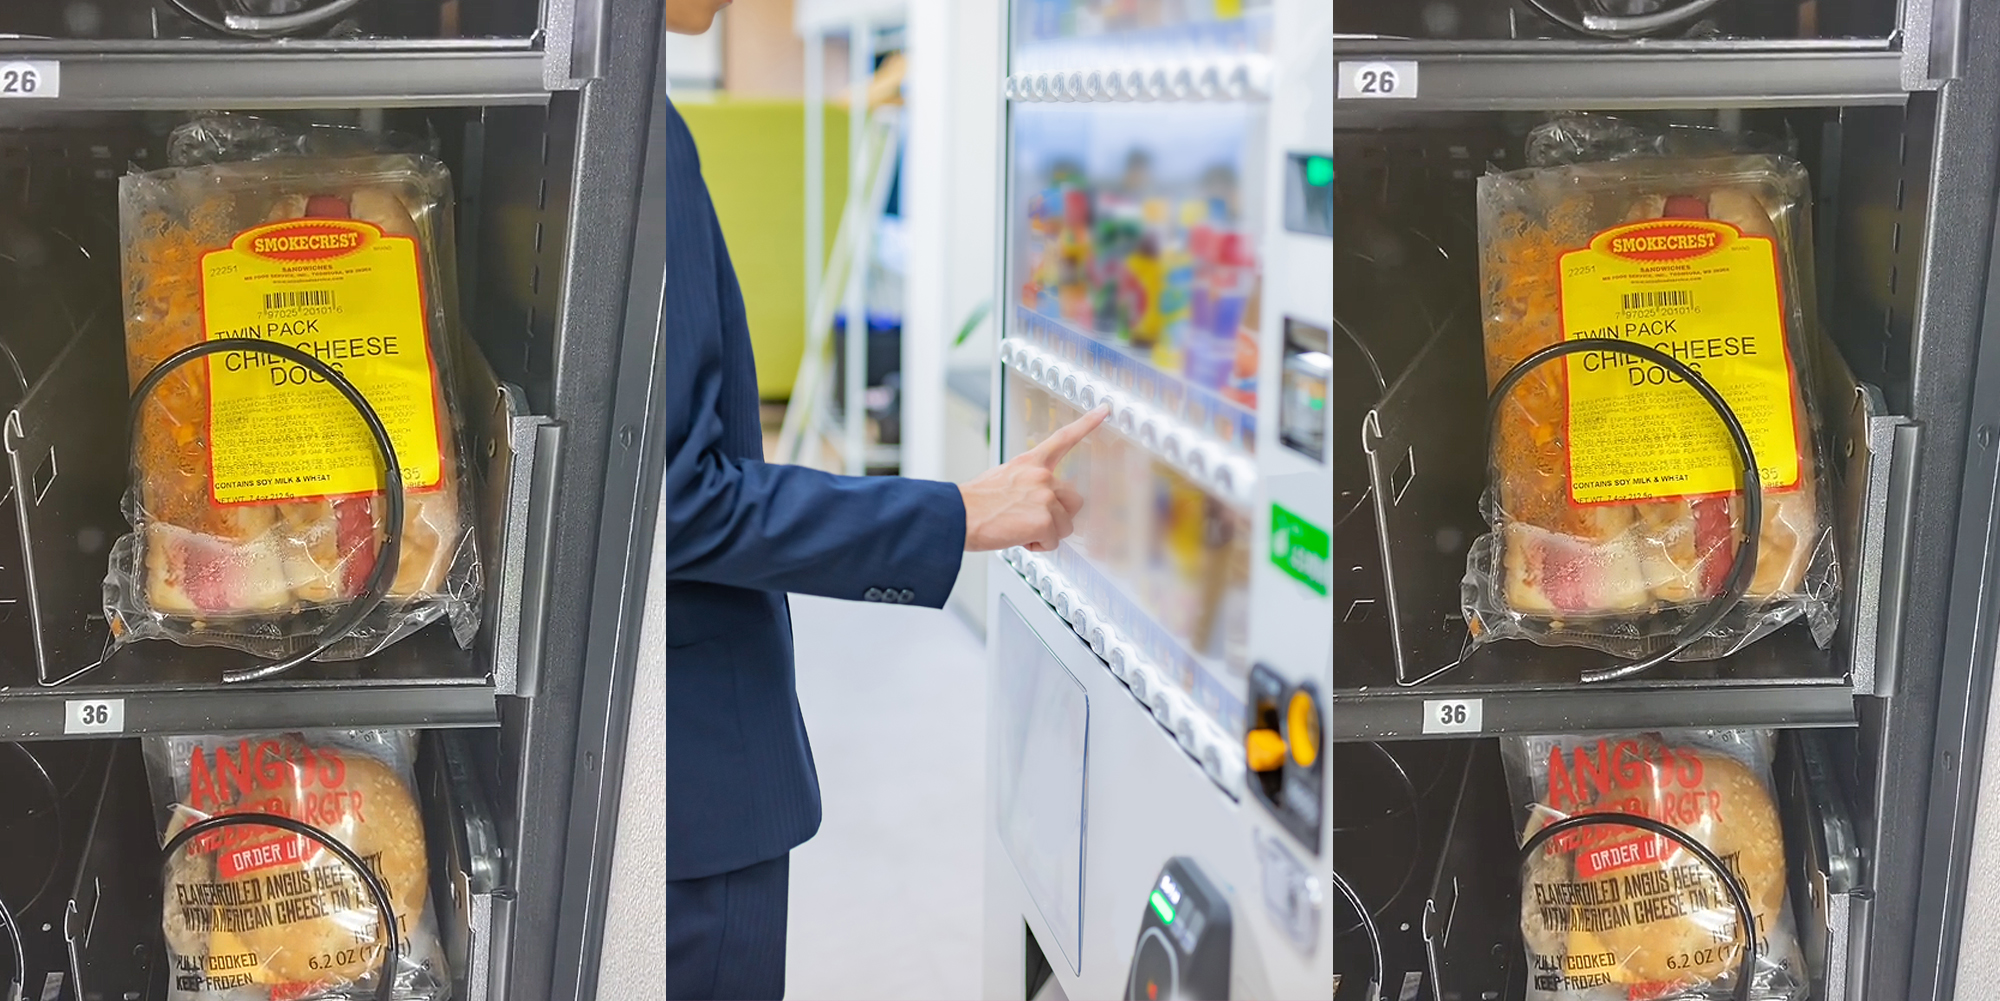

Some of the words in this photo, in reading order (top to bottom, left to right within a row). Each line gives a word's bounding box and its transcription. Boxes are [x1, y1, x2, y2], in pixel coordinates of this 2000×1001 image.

[3, 70, 36, 92] 26
[1361, 70, 1394, 92] 26
[254, 232, 358, 253] SMOKECREST
[1612, 232, 1716, 253] SMOKECREST
[210, 265, 238, 277] 22251
[282, 264, 333, 272] SANDWICHES
[1568, 265, 1596, 277] 22251
[1640, 264, 1691, 272] SANDWICHES
[268, 309, 298, 318] 97025
[303, 307, 333, 316] 20101
[1626, 309, 1656, 318] 97025
[1661, 307, 1691, 316] 20101
[215, 325, 261, 340] TWIN
[268, 319, 320, 337] PACK
[1573, 325, 1619, 340] TWIN
[1626, 319, 1678, 337] PACK
[225, 351, 288, 372] CHIL
[1583, 351, 1646, 372] CHIL
[215, 480, 254, 489] CONTAINS
[275, 476, 293, 484] MILK
[303, 474, 331, 482] WHEAT
[400, 467, 421, 480] 35
[1573, 480, 1612, 489] CONTAINS
[1633, 476, 1651, 484] MILK
[1661, 474, 1689, 482] WHEAT
[1758, 467, 1779, 480] 35
[82, 704, 109, 724] 36
[1440, 704, 1467, 724] 36
[189, 738, 346, 810] ANGUS
[1547, 738, 1704, 810] ANGUS
[232, 842, 283, 870] ORDER
[1590, 842, 1641, 870] ORDER
[266, 869, 312, 900] ANGUS
[1624, 869, 1670, 900] ANGUS
[182, 907, 209, 932] WITH
[213, 904, 273, 933] AMERICAN
[277, 892, 330, 926] CHEESE
[330, 888, 352, 913] ON
[1540, 907, 1567, 932] WITH
[1571, 904, 1631, 933] AMERICAN
[1635, 892, 1688, 926] CHEESE
[1688, 888, 1710, 913] ON
[209, 952, 258, 971] COOKED
[308, 954, 332, 971] 6.2
[336, 949, 356, 966] OZ
[1567, 952, 1616, 971] COOKED
[1666, 954, 1690, 971] 6.2
[1694, 949, 1714, 966] OZ
[175, 975, 203, 992] KEEP
[206, 972, 254, 991] FROZEN
[1533, 975, 1561, 992] KEEP
[1564, 972, 1612, 991] FROZEN
